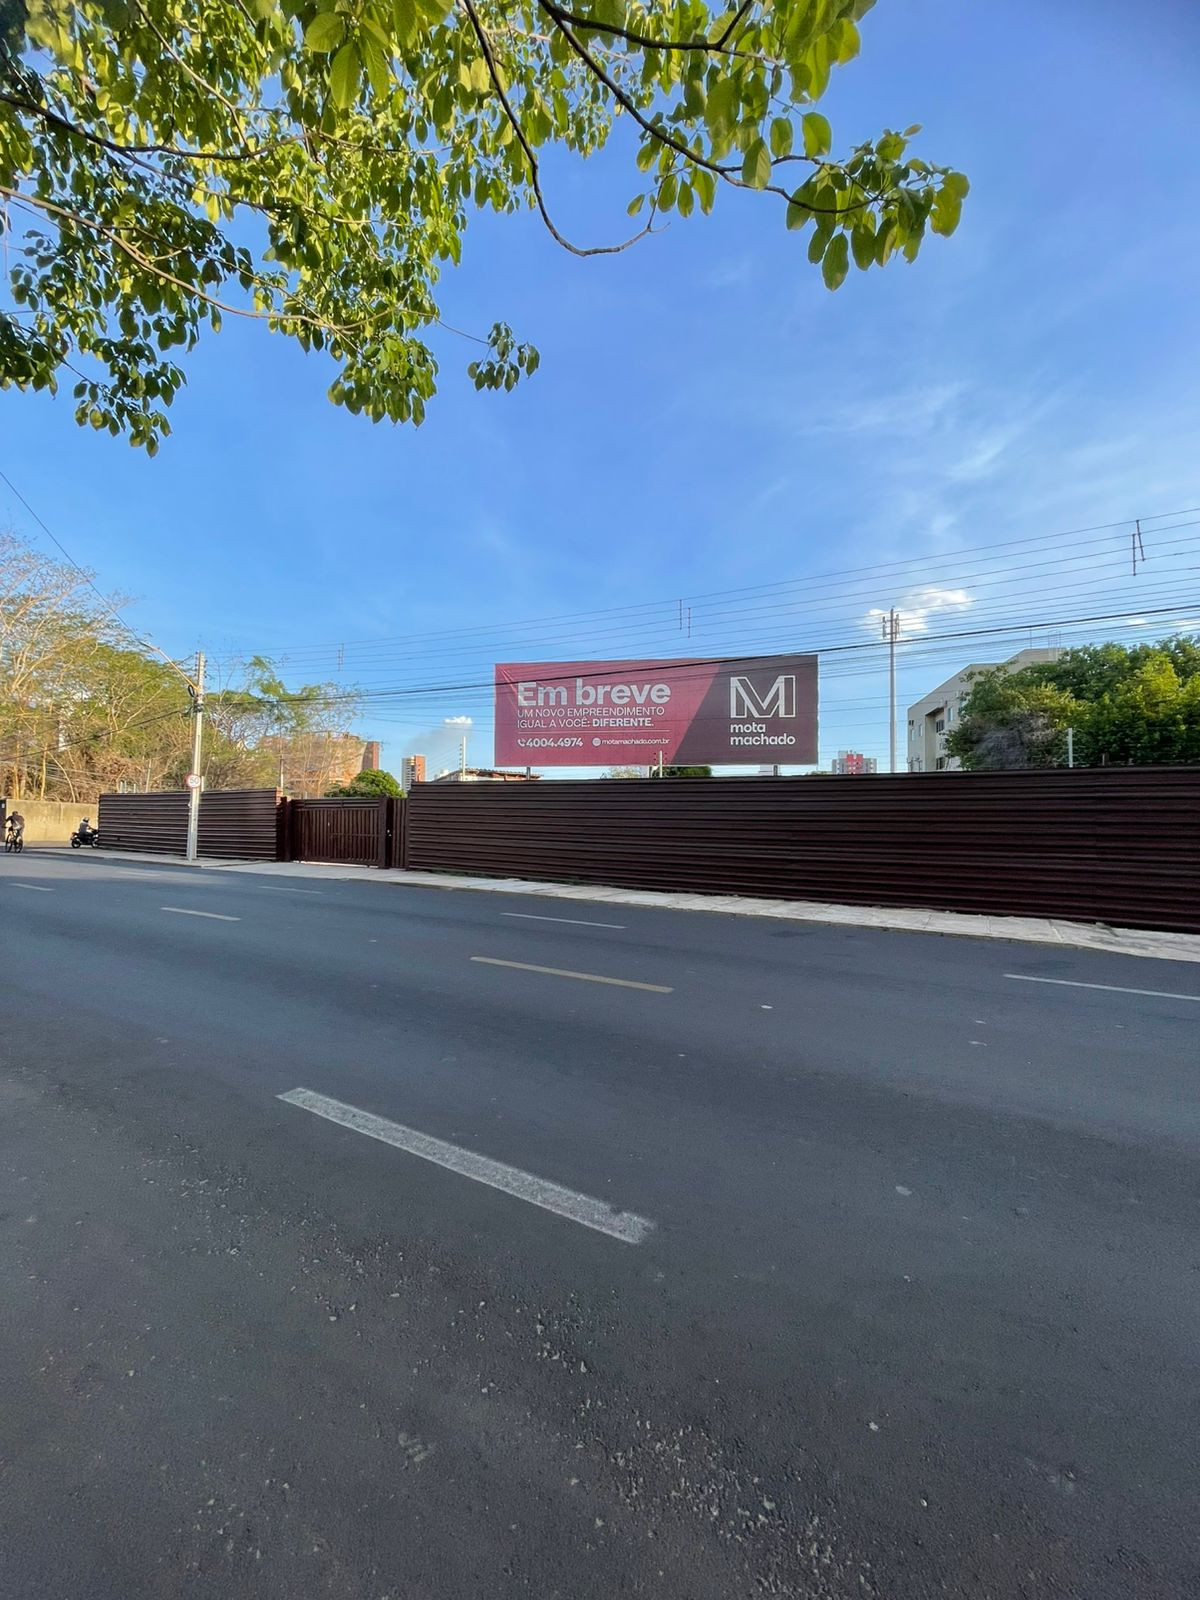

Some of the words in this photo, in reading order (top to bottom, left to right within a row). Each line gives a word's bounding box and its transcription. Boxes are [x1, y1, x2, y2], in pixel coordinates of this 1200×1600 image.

[517, 682, 568, 706] Em
[576, 677, 671, 706] breve
[517, 709, 533, 718] UM
[535, 708, 565, 717] NOVO
[568, 706, 665, 717] EMPREENDIMENTO
[517, 719, 547, 729] IGUAL
[548, 719, 557, 728] A
[559, 717, 590, 728] VOCÊ:
[592, 718, 654, 728] DIFERENTE.
[730, 721, 766, 733] mota
[526, 737, 584, 748] 4004.4974
[602, 738, 670, 746] motamachado.com.br
[730, 733, 796, 746] machado
